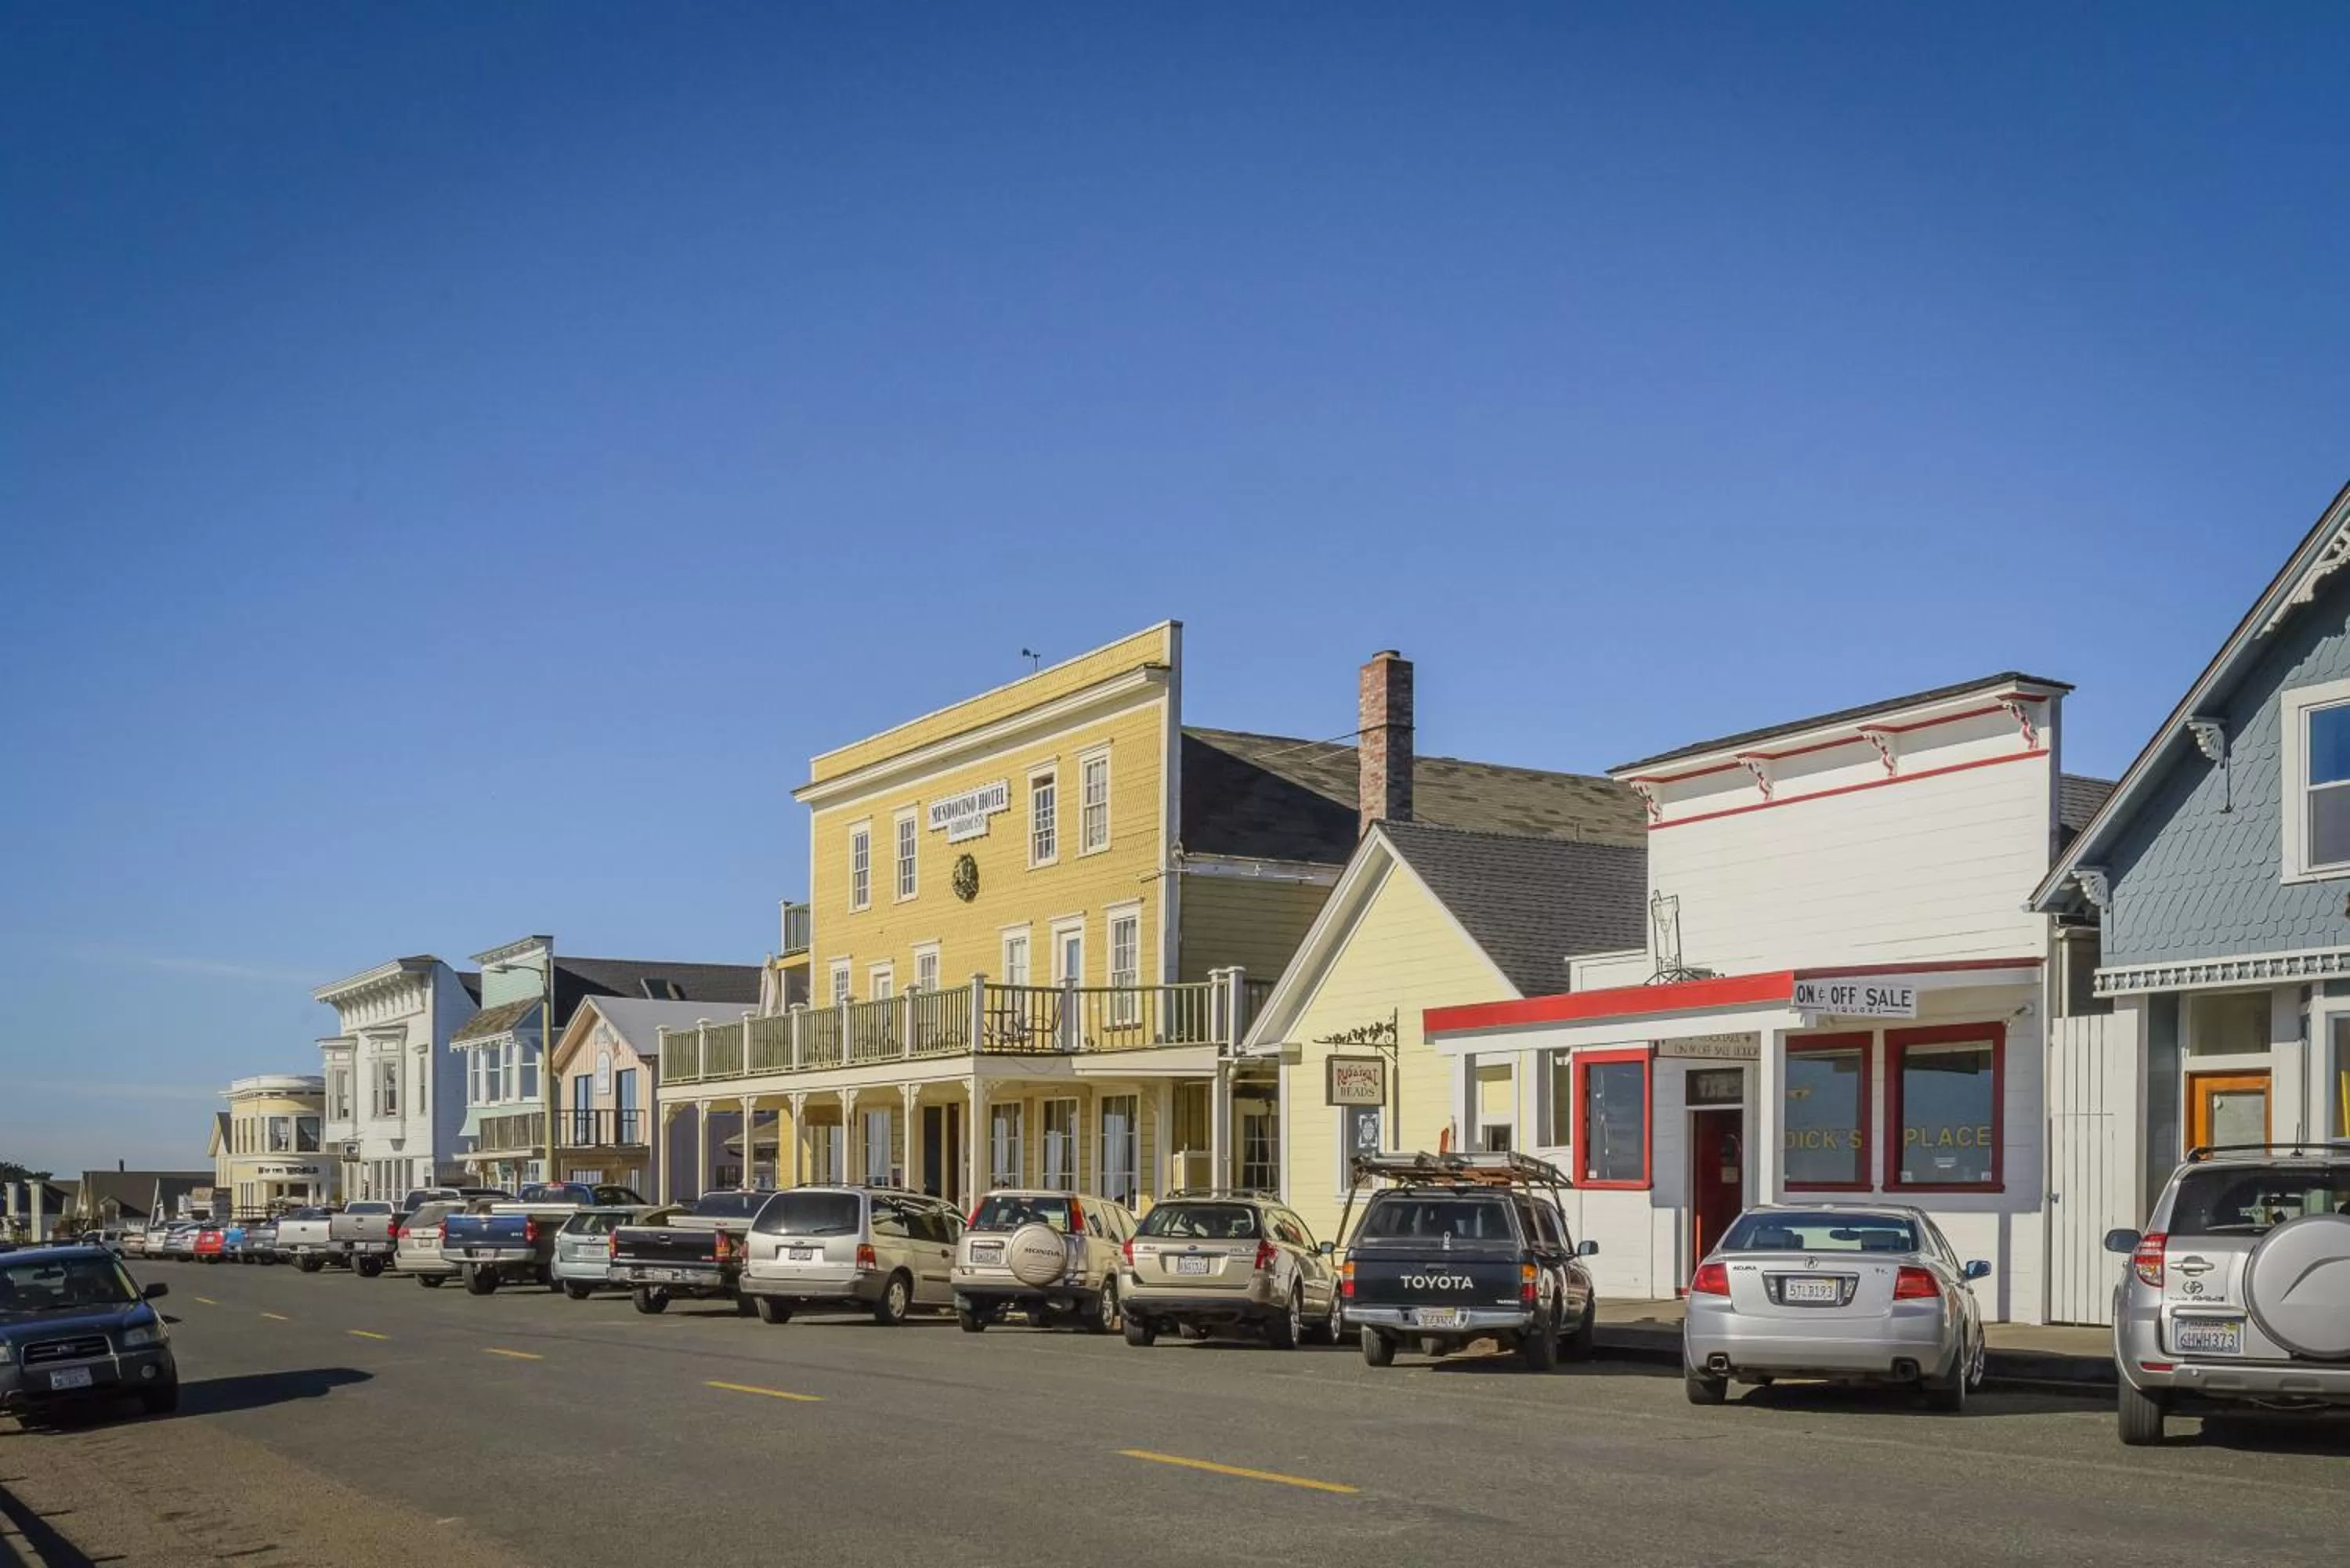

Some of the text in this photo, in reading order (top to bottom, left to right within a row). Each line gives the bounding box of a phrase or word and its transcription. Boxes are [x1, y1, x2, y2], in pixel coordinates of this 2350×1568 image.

[931, 795, 976, 825] MENDOCINO
[978, 787, 1004, 811] HOTEL
[1797, 985, 1815, 1003] ON
[1831, 986, 1856, 1005] OFF
[1865, 988, 1911, 1008] SALE
[1340, 1086, 1376, 1097] BEADS
[1904, 1125, 1993, 1149] PLACE
[1024, 1246, 1061, 1257] HONDA
[1400, 1274, 1473, 1290] TOYOTA
